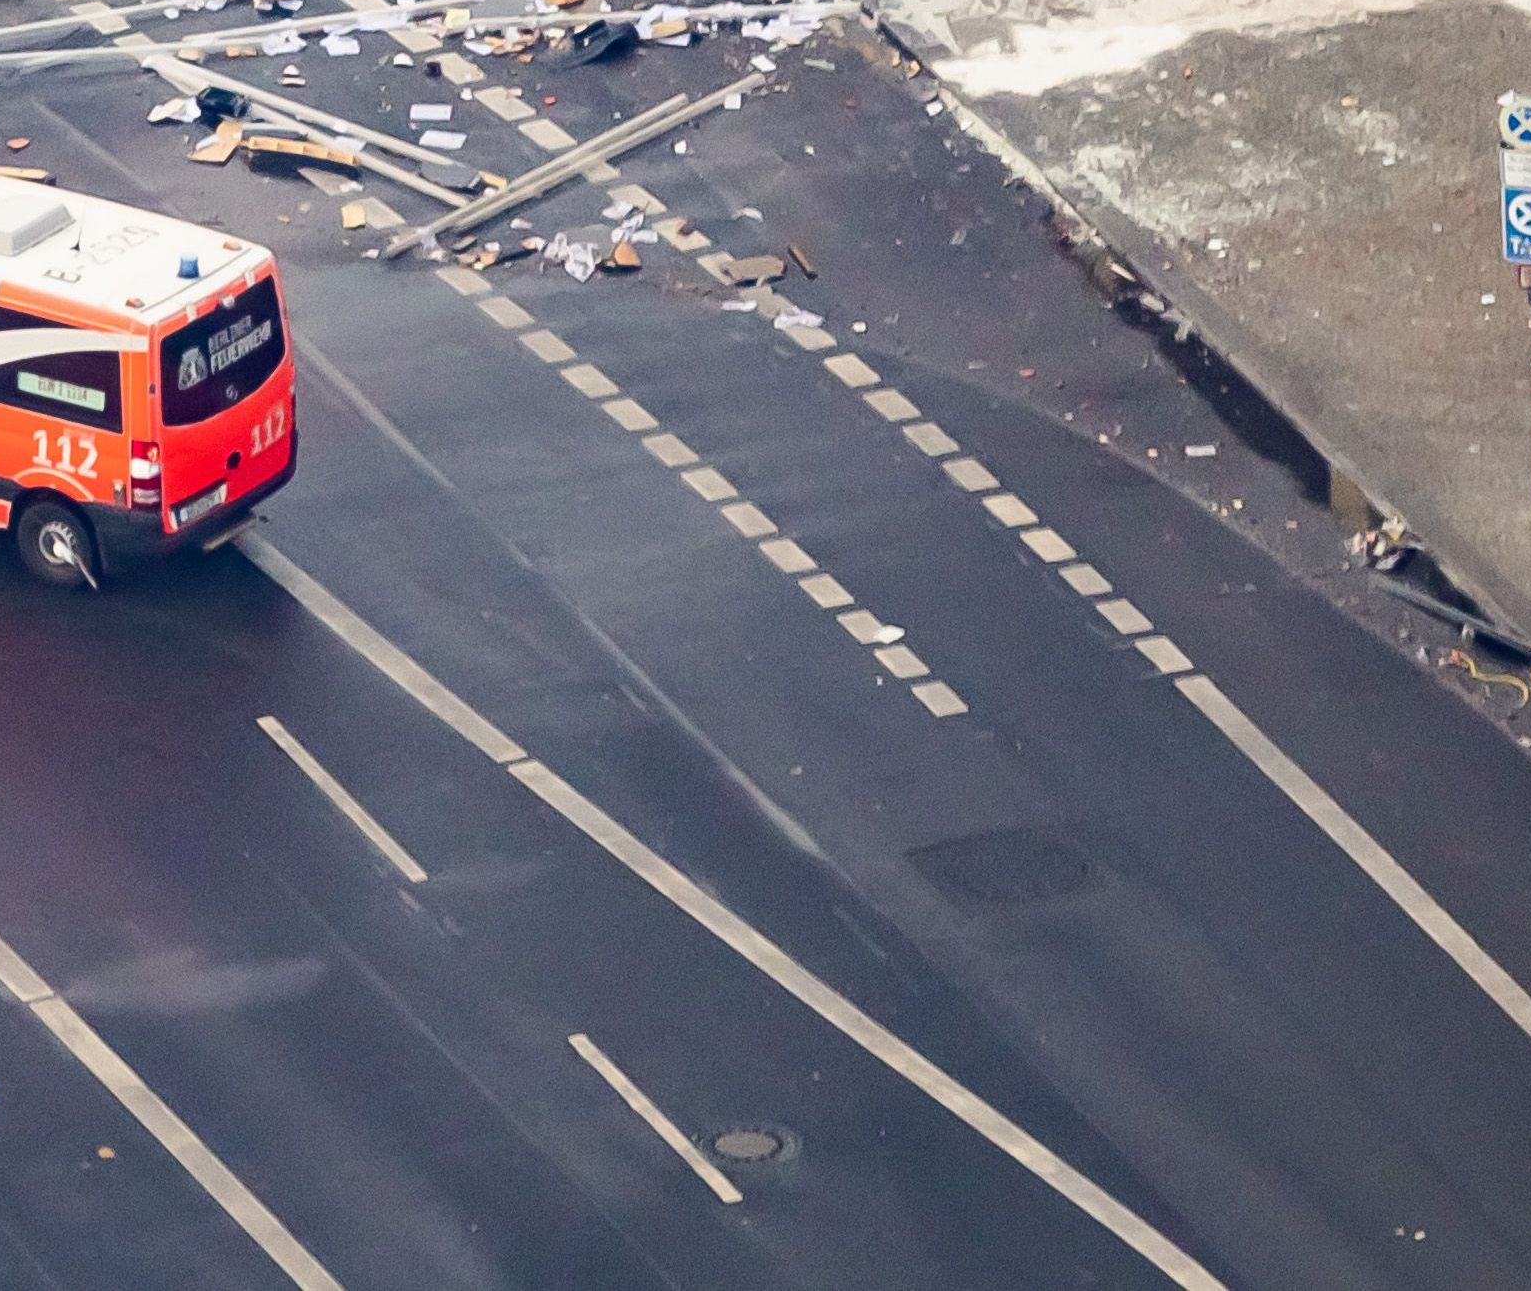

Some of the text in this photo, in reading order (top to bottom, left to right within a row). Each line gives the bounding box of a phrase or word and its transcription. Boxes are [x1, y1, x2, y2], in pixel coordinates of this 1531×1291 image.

[211, 319, 271, 375] FEUERWEHR
[32, 429, 98, 479] 112
[251, 407, 286, 458] 112
